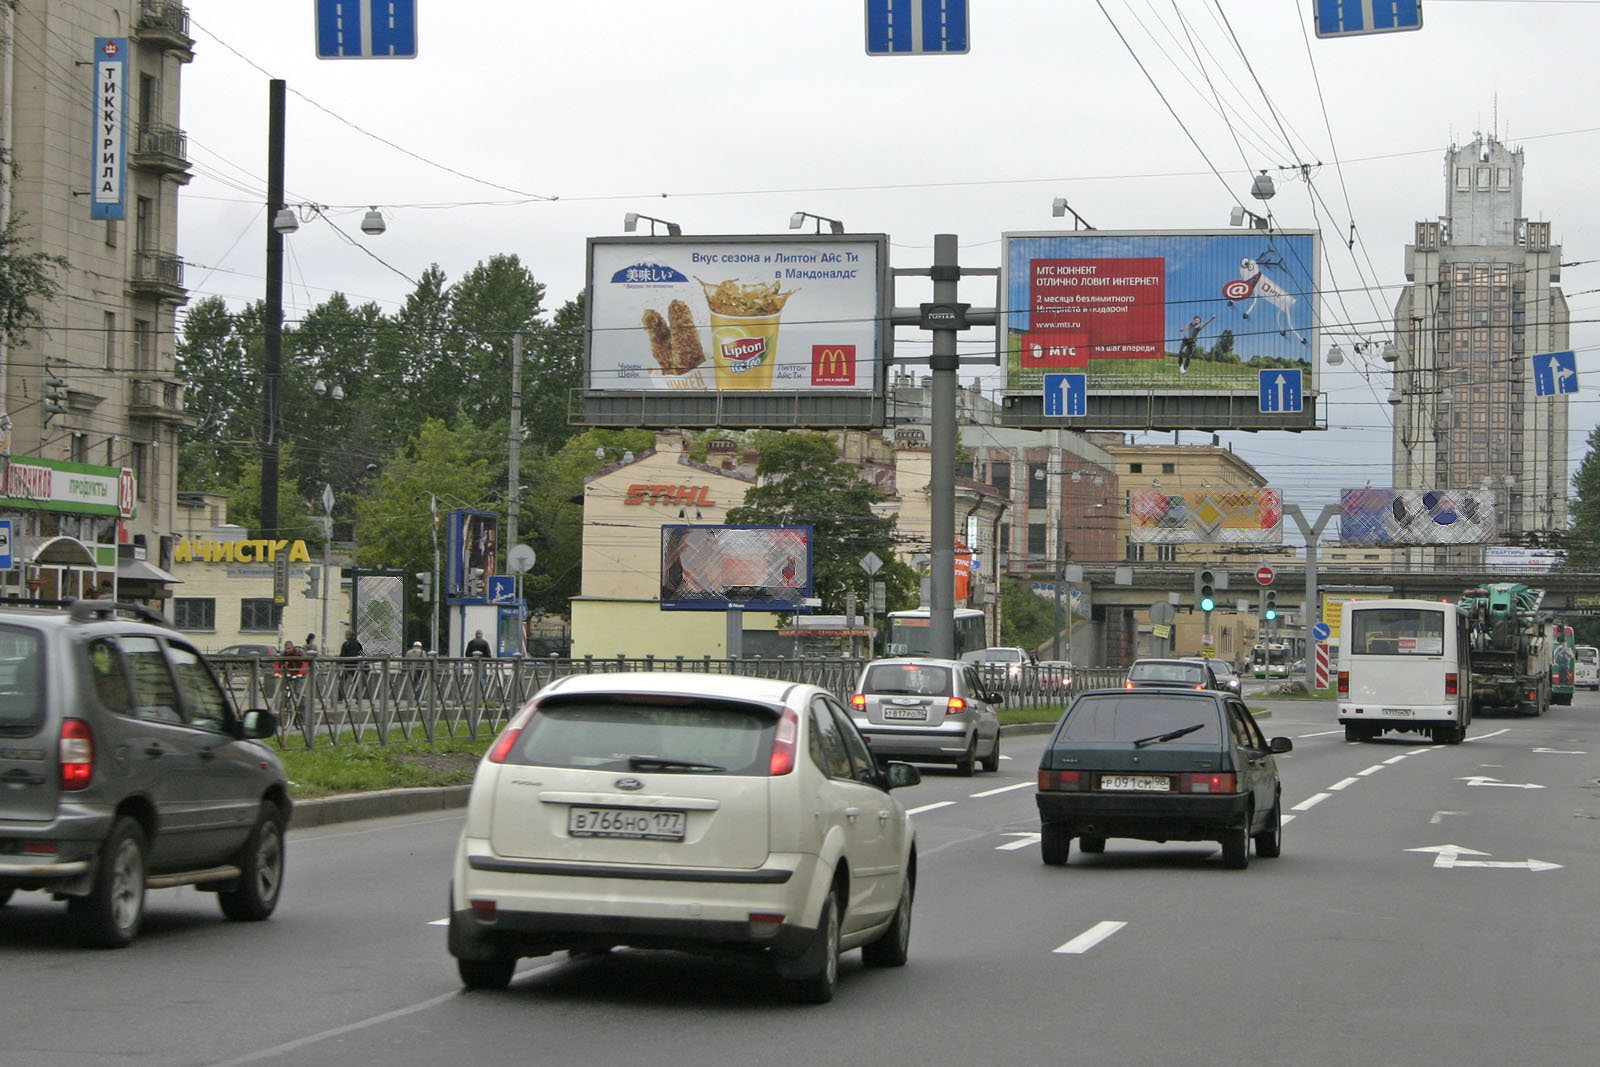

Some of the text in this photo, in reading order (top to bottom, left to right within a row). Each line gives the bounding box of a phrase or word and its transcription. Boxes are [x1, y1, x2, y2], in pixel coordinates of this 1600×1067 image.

[102, 68, 115, 192] ТИККУРИЛА
[692, 252, 859, 265] Вкус сезона и Липтон Айс Ти
[626, 268, 674, 282] 美味しい
[775, 268, 857, 280] в Макдоналдс
[1036, 266, 1096, 275] МТС КОННЕКТ
[1036, 276, 1159, 287] ОТЛИЧНО ЛОВИТ ИНТЕРНЕТ!
[1036, 295, 1135, 304] 2 месяца безлимитного
[724, 342, 762, 358] Lipton
[69, 479, 108, 498] ПРОДУКТЫ
[624, 484, 716, 507] STIHL
[1154, 776, 1167, 786] 98
[576, 811, 680, 832] В766НО 177
